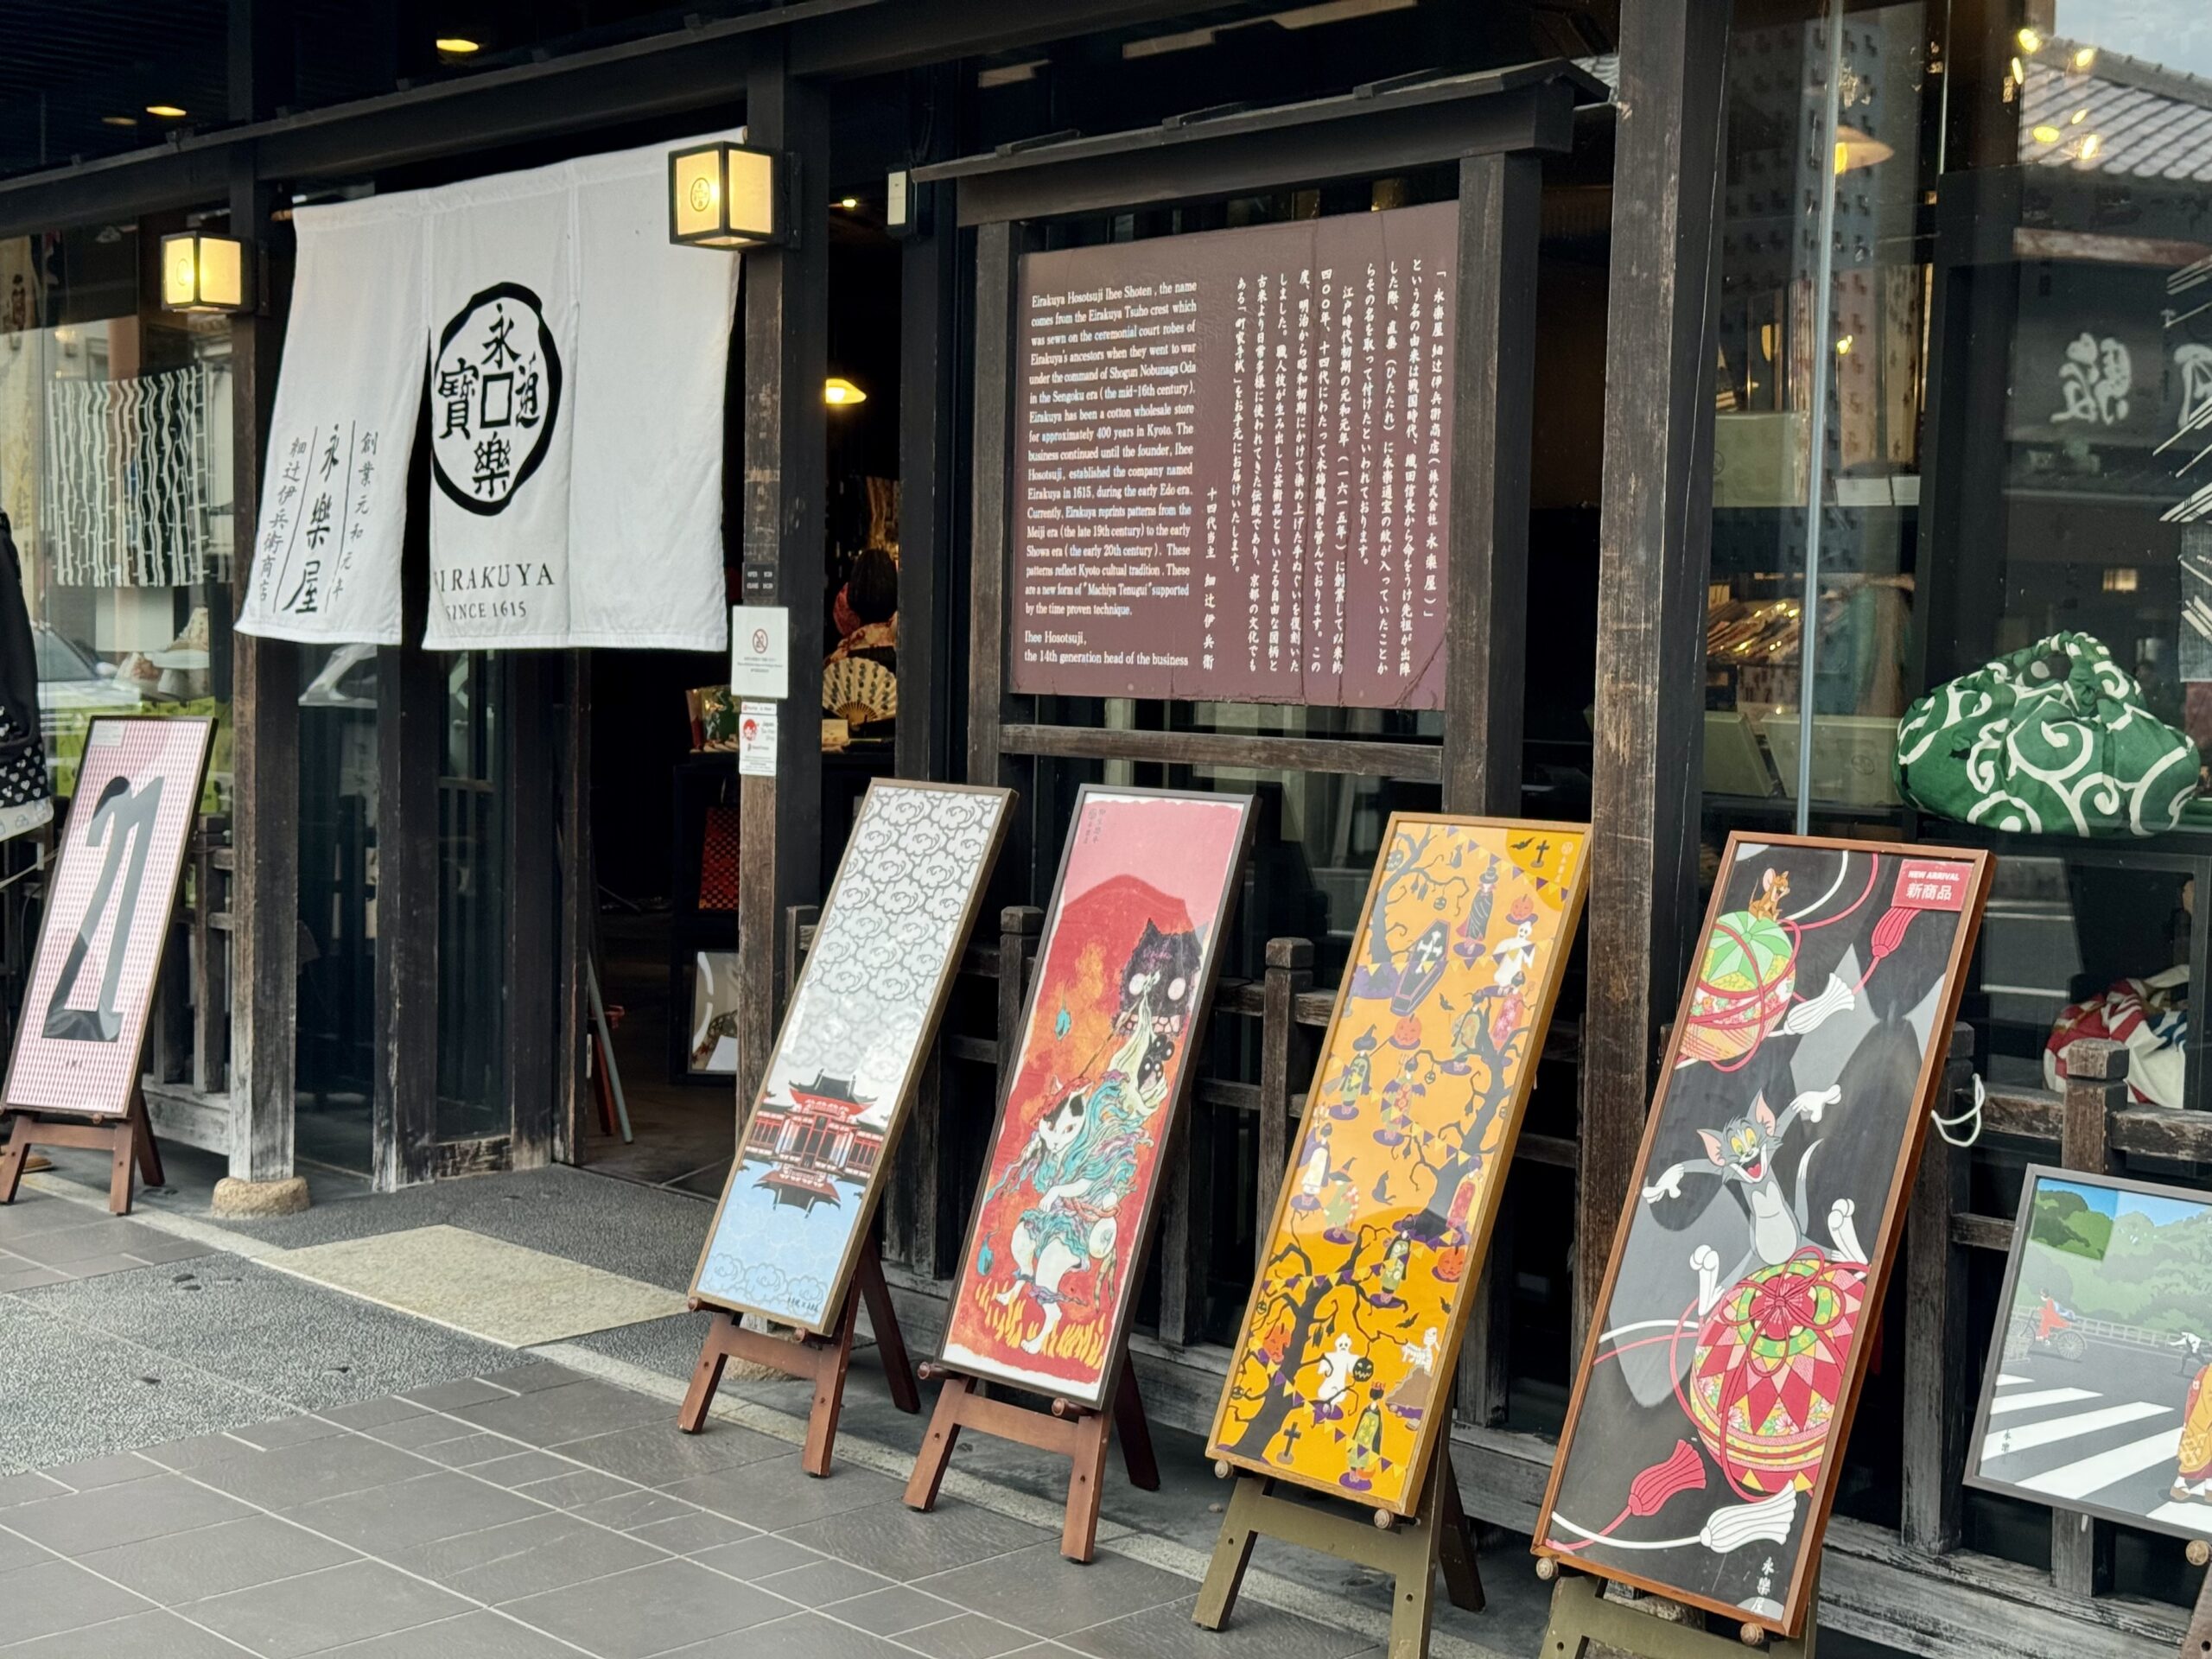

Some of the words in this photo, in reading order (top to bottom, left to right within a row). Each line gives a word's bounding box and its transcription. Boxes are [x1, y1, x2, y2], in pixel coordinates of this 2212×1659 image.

[1032, 294, 1065, 308] Eirakuya
[1067, 289, 1103, 304] Hosotsuji
[1105, 287, 1122, 301] Ihee
[1160, 282, 1173, 295] the
[1174, 282, 1197, 293] name
[1031, 316, 1053, 327] comes
[1055, 312, 1073, 325] from
[1075, 310, 1087, 323] the
[1089, 308, 1122, 322] Eirakuya
[1150, 304, 1169, 315] crest
[1173, 299, 1197, 313] which
[1031, 337, 1046, 346] was
[1046, 334, 1066, 345] sewn
[1068, 334, 1078, 343] on
[1080, 329, 1092, 342] the
[1094, 324, 1137, 340] ceremonial
[1138, 325, 1160, 337] court
[1163, 321, 1185, 335] robes
[1186, 319, 1196, 333] of
[1070, 351, 1104, 363] ancestors
[1106, 346, 1128, 359] when
[1129, 345, 1147, 359] they
[1149, 344, 1168, 355] went
[1172, 344, 1179, 354] to
[1180, 343, 1197, 353] war
[1029, 372, 1051, 385] under
[1052, 371, 1064, 384] the
[1064, 367, 1098, 382] command
[1099, 366, 1109, 379] of
[1109, 366, 1138, 380] Shogun
[1140, 364, 1179, 377] Nobunaga
[1179, 360, 1196, 374] Oda
[1030, 392, 1038, 404] in
[1039, 391, 1051, 404] the
[1052, 389, 1084, 404] Sengoku
[1085, 391, 1098, 400] era
[1029, 410, 1062, 424] Eirakuya
[1065, 409, 1077, 422] has
[1079, 409, 1097, 421] been
[1107, 408, 1132, 419] cotton
[1134, 403, 1172, 416] wholesale
[1174, 404, 1194, 415] store
[1029, 429, 1040, 442] for
[1042, 427, 1094, 444] approximately
[1096, 426, 1111, 439] 400
[1114, 428, 1135, 441] years
[1136, 424, 1145, 437] in
[1176, 422, 1193, 435] The
[1028, 449, 1059, 461] business
[1060, 446, 1099, 461] continued
[1101, 445, 1120, 459] until
[1122, 445, 1135, 458] the
[1175, 442, 1193, 455] Ihee
[1069, 465, 1110, 480] established
[1113, 465, 1126, 478] the
[1128, 467, 1164, 479] company
[1166, 462, 1192, 475] named
[1027, 487, 1061, 501] Eirakuya
[1063, 486, 1071, 499] in
[1096, 485, 1122, 499] during
[1124, 484, 1136, 497] the
[1137, 484, 1158, 499] early
[1160, 483, 1176, 496] Edo
[282, 423, 340, 614] 永樂屋
[1065, 505, 1096, 519] Eirakuya
[1098, 505, 1126, 519] reprints
[1127, 506, 1157, 519] patterns
[1158, 503, 1176, 516] from
[1179, 503, 1192, 515] the
[1027, 525, 1046, 540] Meiji
[1046, 529, 1058, 537] era
[1077, 525, 1091, 537] late
[1093, 524, 1110, 537] 19th
[1146, 525, 1154, 536] to
[1156, 523, 1169, 536] the
[1170, 523, 1191, 537] early
[1027, 545, 1050, 557] Showa
[1052, 548, 1063, 557] era
[1083, 543, 1102, 559] early
[1103, 543, 1121, 556] 20th
[1166, 543, 1191, 556] These
[434, 563, 555, 592] IRAKUYA
[1026, 566, 1053, 578] patterns
[1055, 563, 1077, 576] reflect
[1078, 563, 1101, 578] Kyoto
[1166, 563, 1191, 575] These
[1042, 586, 1056, 594] new
[1058, 582, 1073, 595] form
[1074, 582, 1082, 595] of
[1152, 583, 1189, 598] supported
[493, 600, 527, 618] 1615
[1026, 602, 1034, 616] by
[1036, 602, 1047, 614] the
[1048, 602, 1065, 614] time
[1066, 605, 1091, 617] proven
[1025, 630, 1042, 643] Ihee
[1024, 649, 1037, 662] the
[1040, 650, 1058, 662] 14th
[1059, 651, 1102, 664] generation
[1103, 651, 1123, 664] head
[1125, 652, 1135, 664] of
[1137, 652, 1151, 664] the
[1152, 652, 1188, 666] business
[1908, 870, 1927, 880] NEW
[1927, 871, 1959, 880] ARRIVAL
[1906, 882, 1953, 901] 新商品
